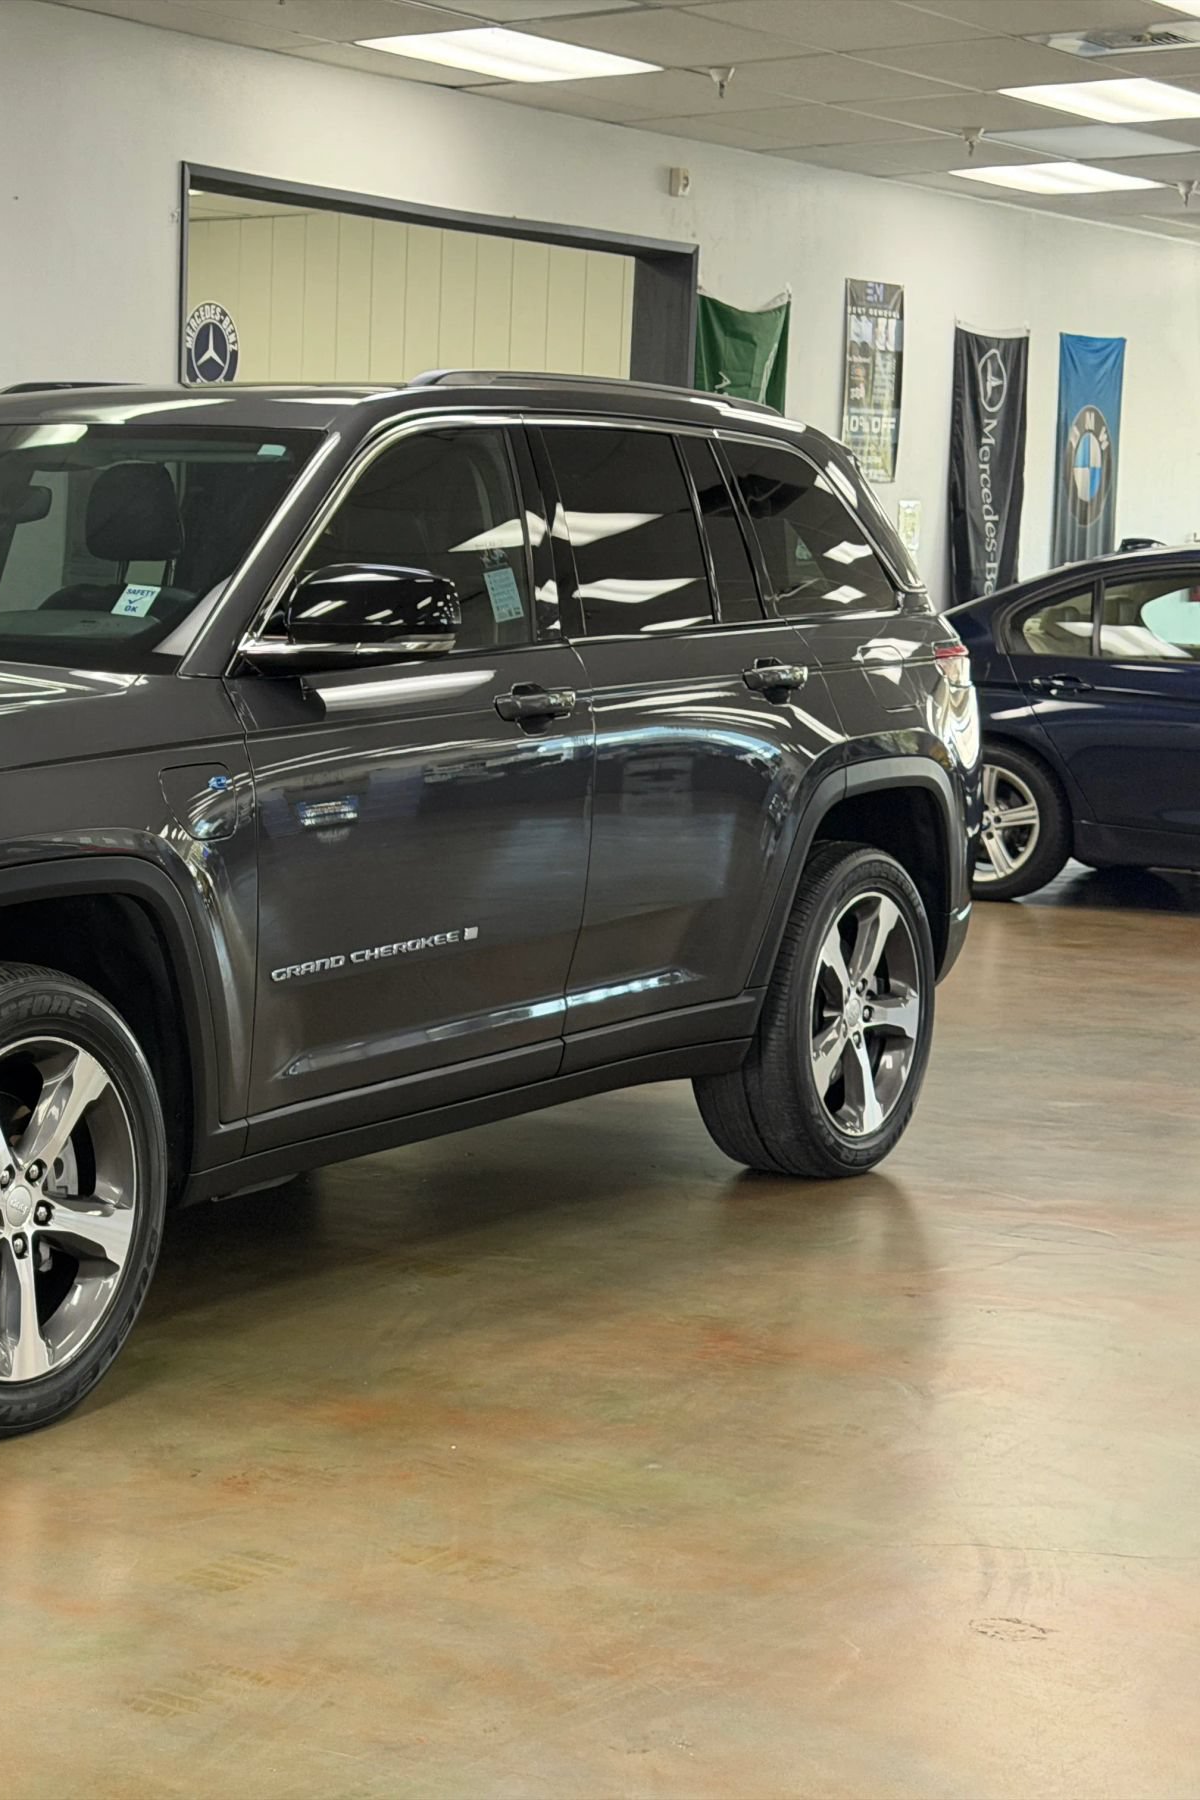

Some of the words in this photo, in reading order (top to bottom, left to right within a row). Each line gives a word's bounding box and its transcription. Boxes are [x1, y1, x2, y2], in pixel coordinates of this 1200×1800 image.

[185, 304, 238, 352] MERCEDES-BENZ
[126, 588, 157, 598] SAFETY
[124, 605, 139, 613] OK
[271, 955, 346, 982] GRAND
[350, 930, 461, 964] CHEROKEE
